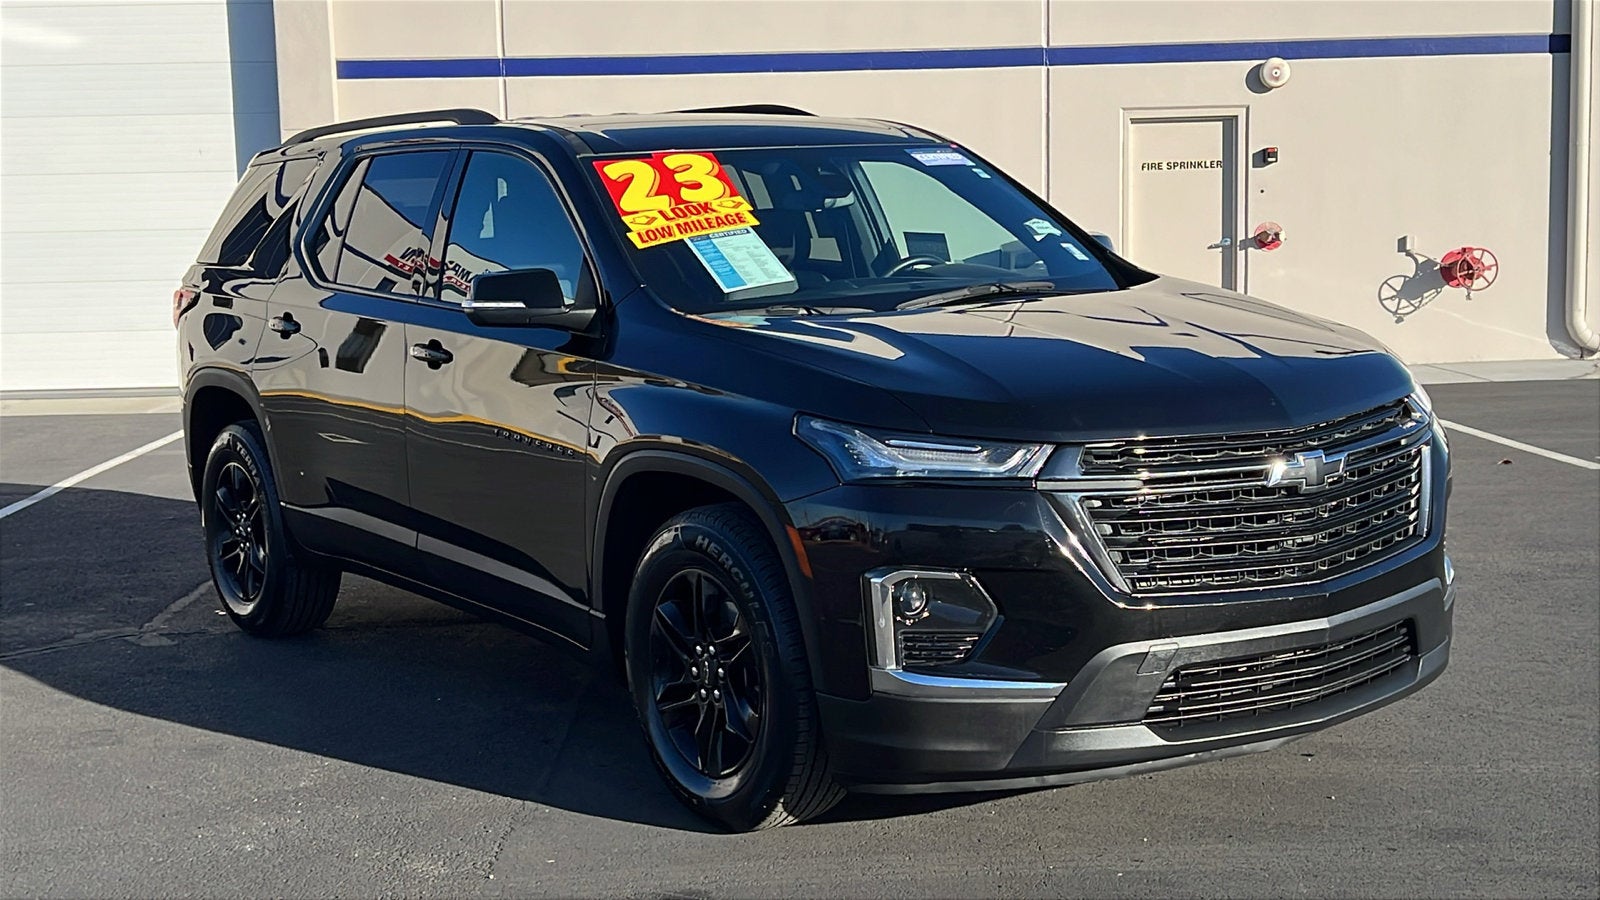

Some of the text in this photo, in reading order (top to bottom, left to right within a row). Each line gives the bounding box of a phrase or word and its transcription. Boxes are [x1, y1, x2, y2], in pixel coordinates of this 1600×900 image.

[1141, 160, 1223, 171] FIRE SPRINKLER
[602, 153, 731, 212] 23
[658, 202, 718, 222] LOOK
[636, 212, 747, 244] LOW MILEAGE
[709, 228, 749, 240] CERTIFIED
